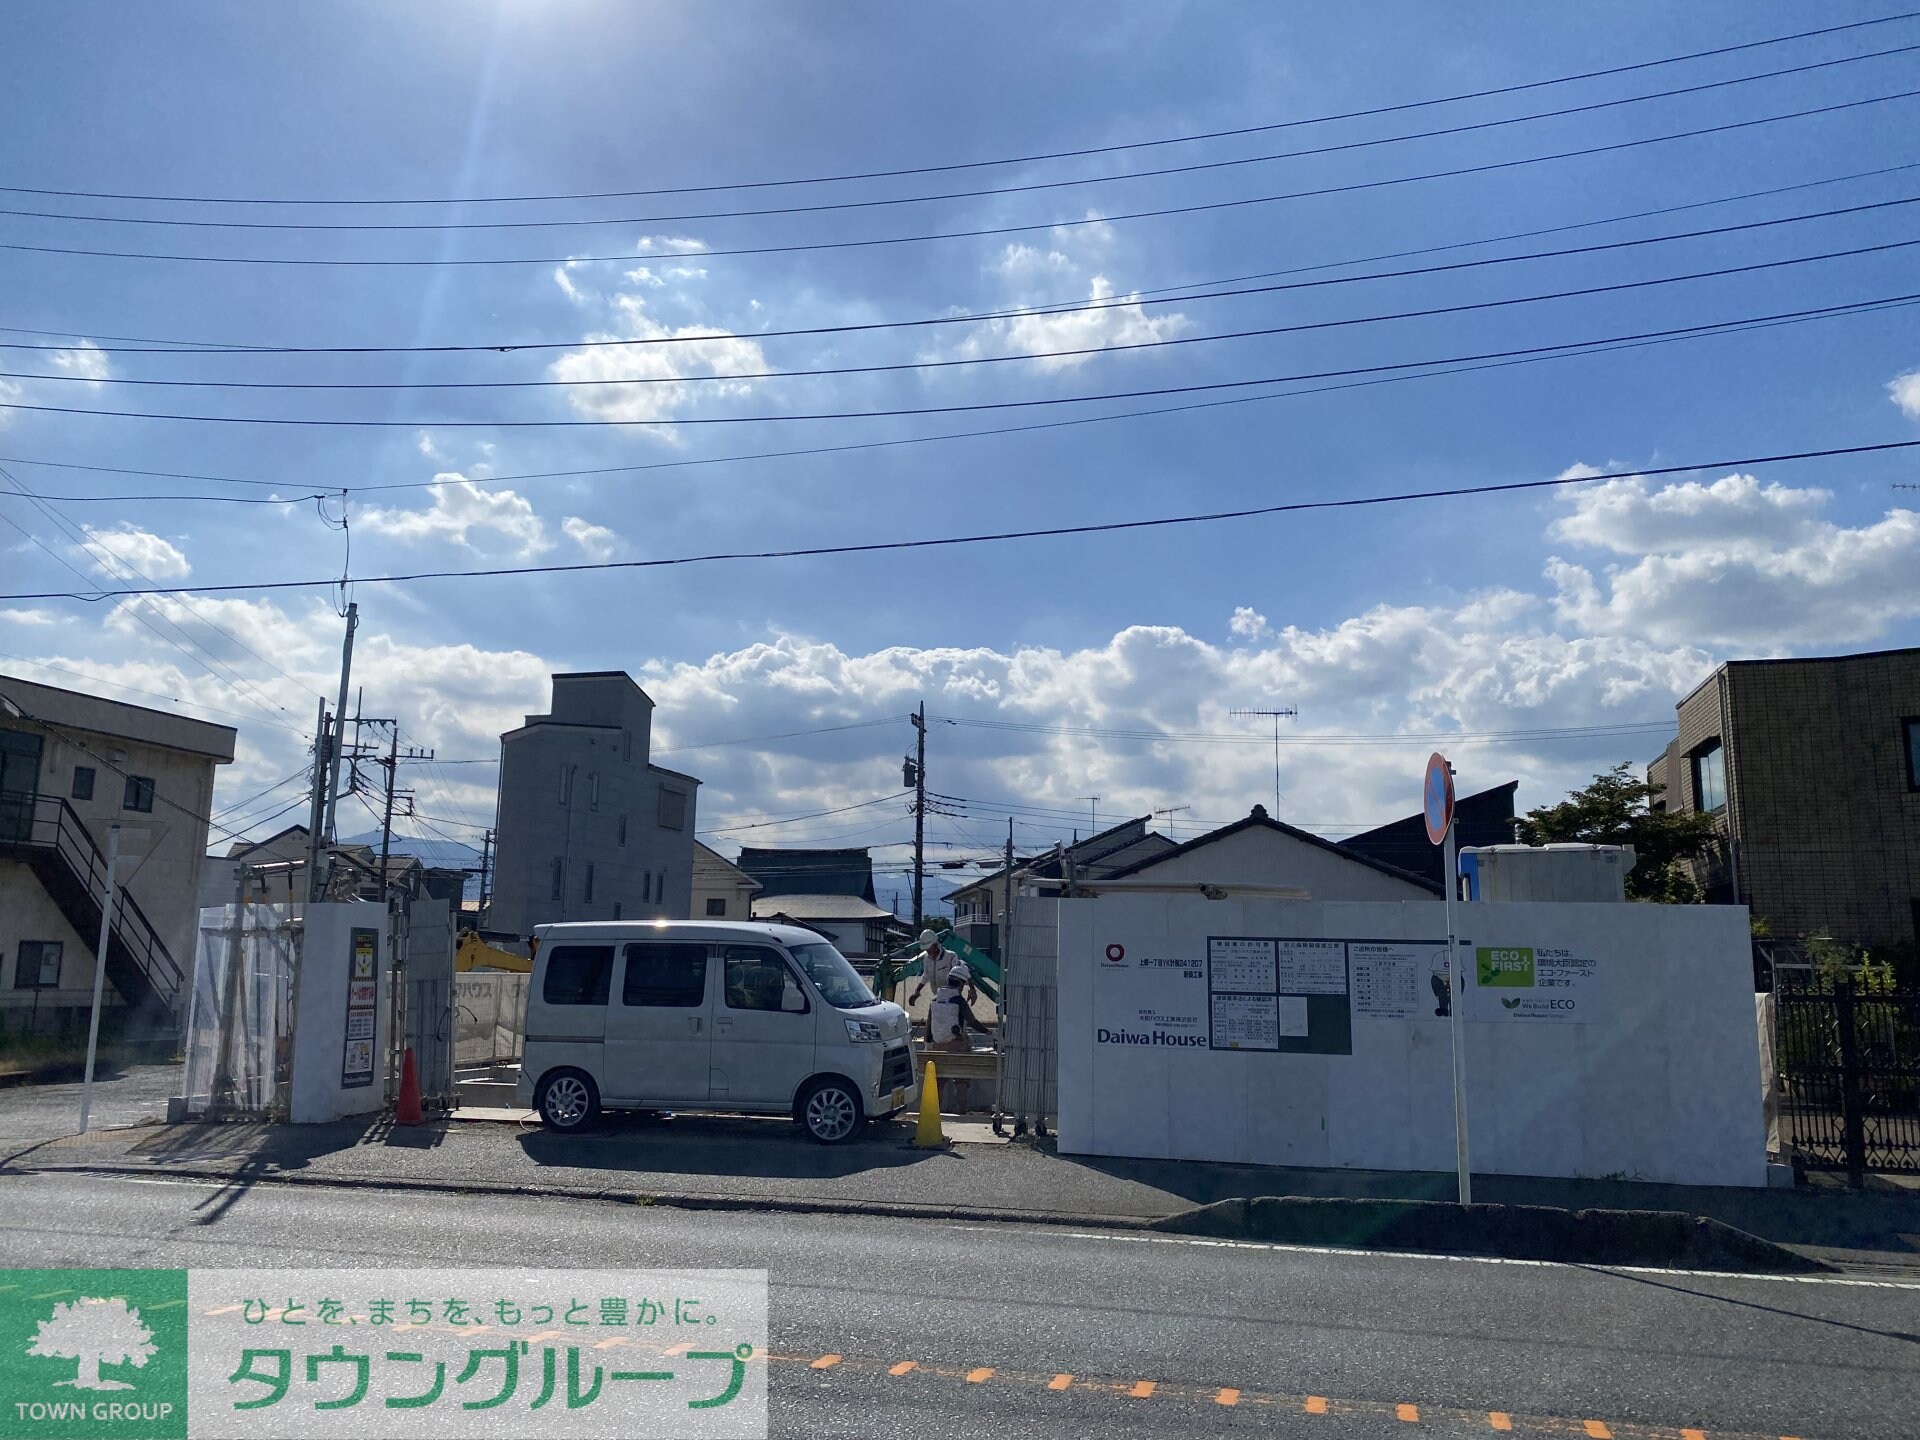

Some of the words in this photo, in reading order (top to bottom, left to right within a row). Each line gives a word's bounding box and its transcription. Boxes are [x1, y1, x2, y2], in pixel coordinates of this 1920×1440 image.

[1490, 951, 1519, 961] ECO
[1550, 999, 1576, 1010] ECO
[1097, 1029, 1150, 1045] Daiwa
[1152, 1030, 1207, 1047] House
